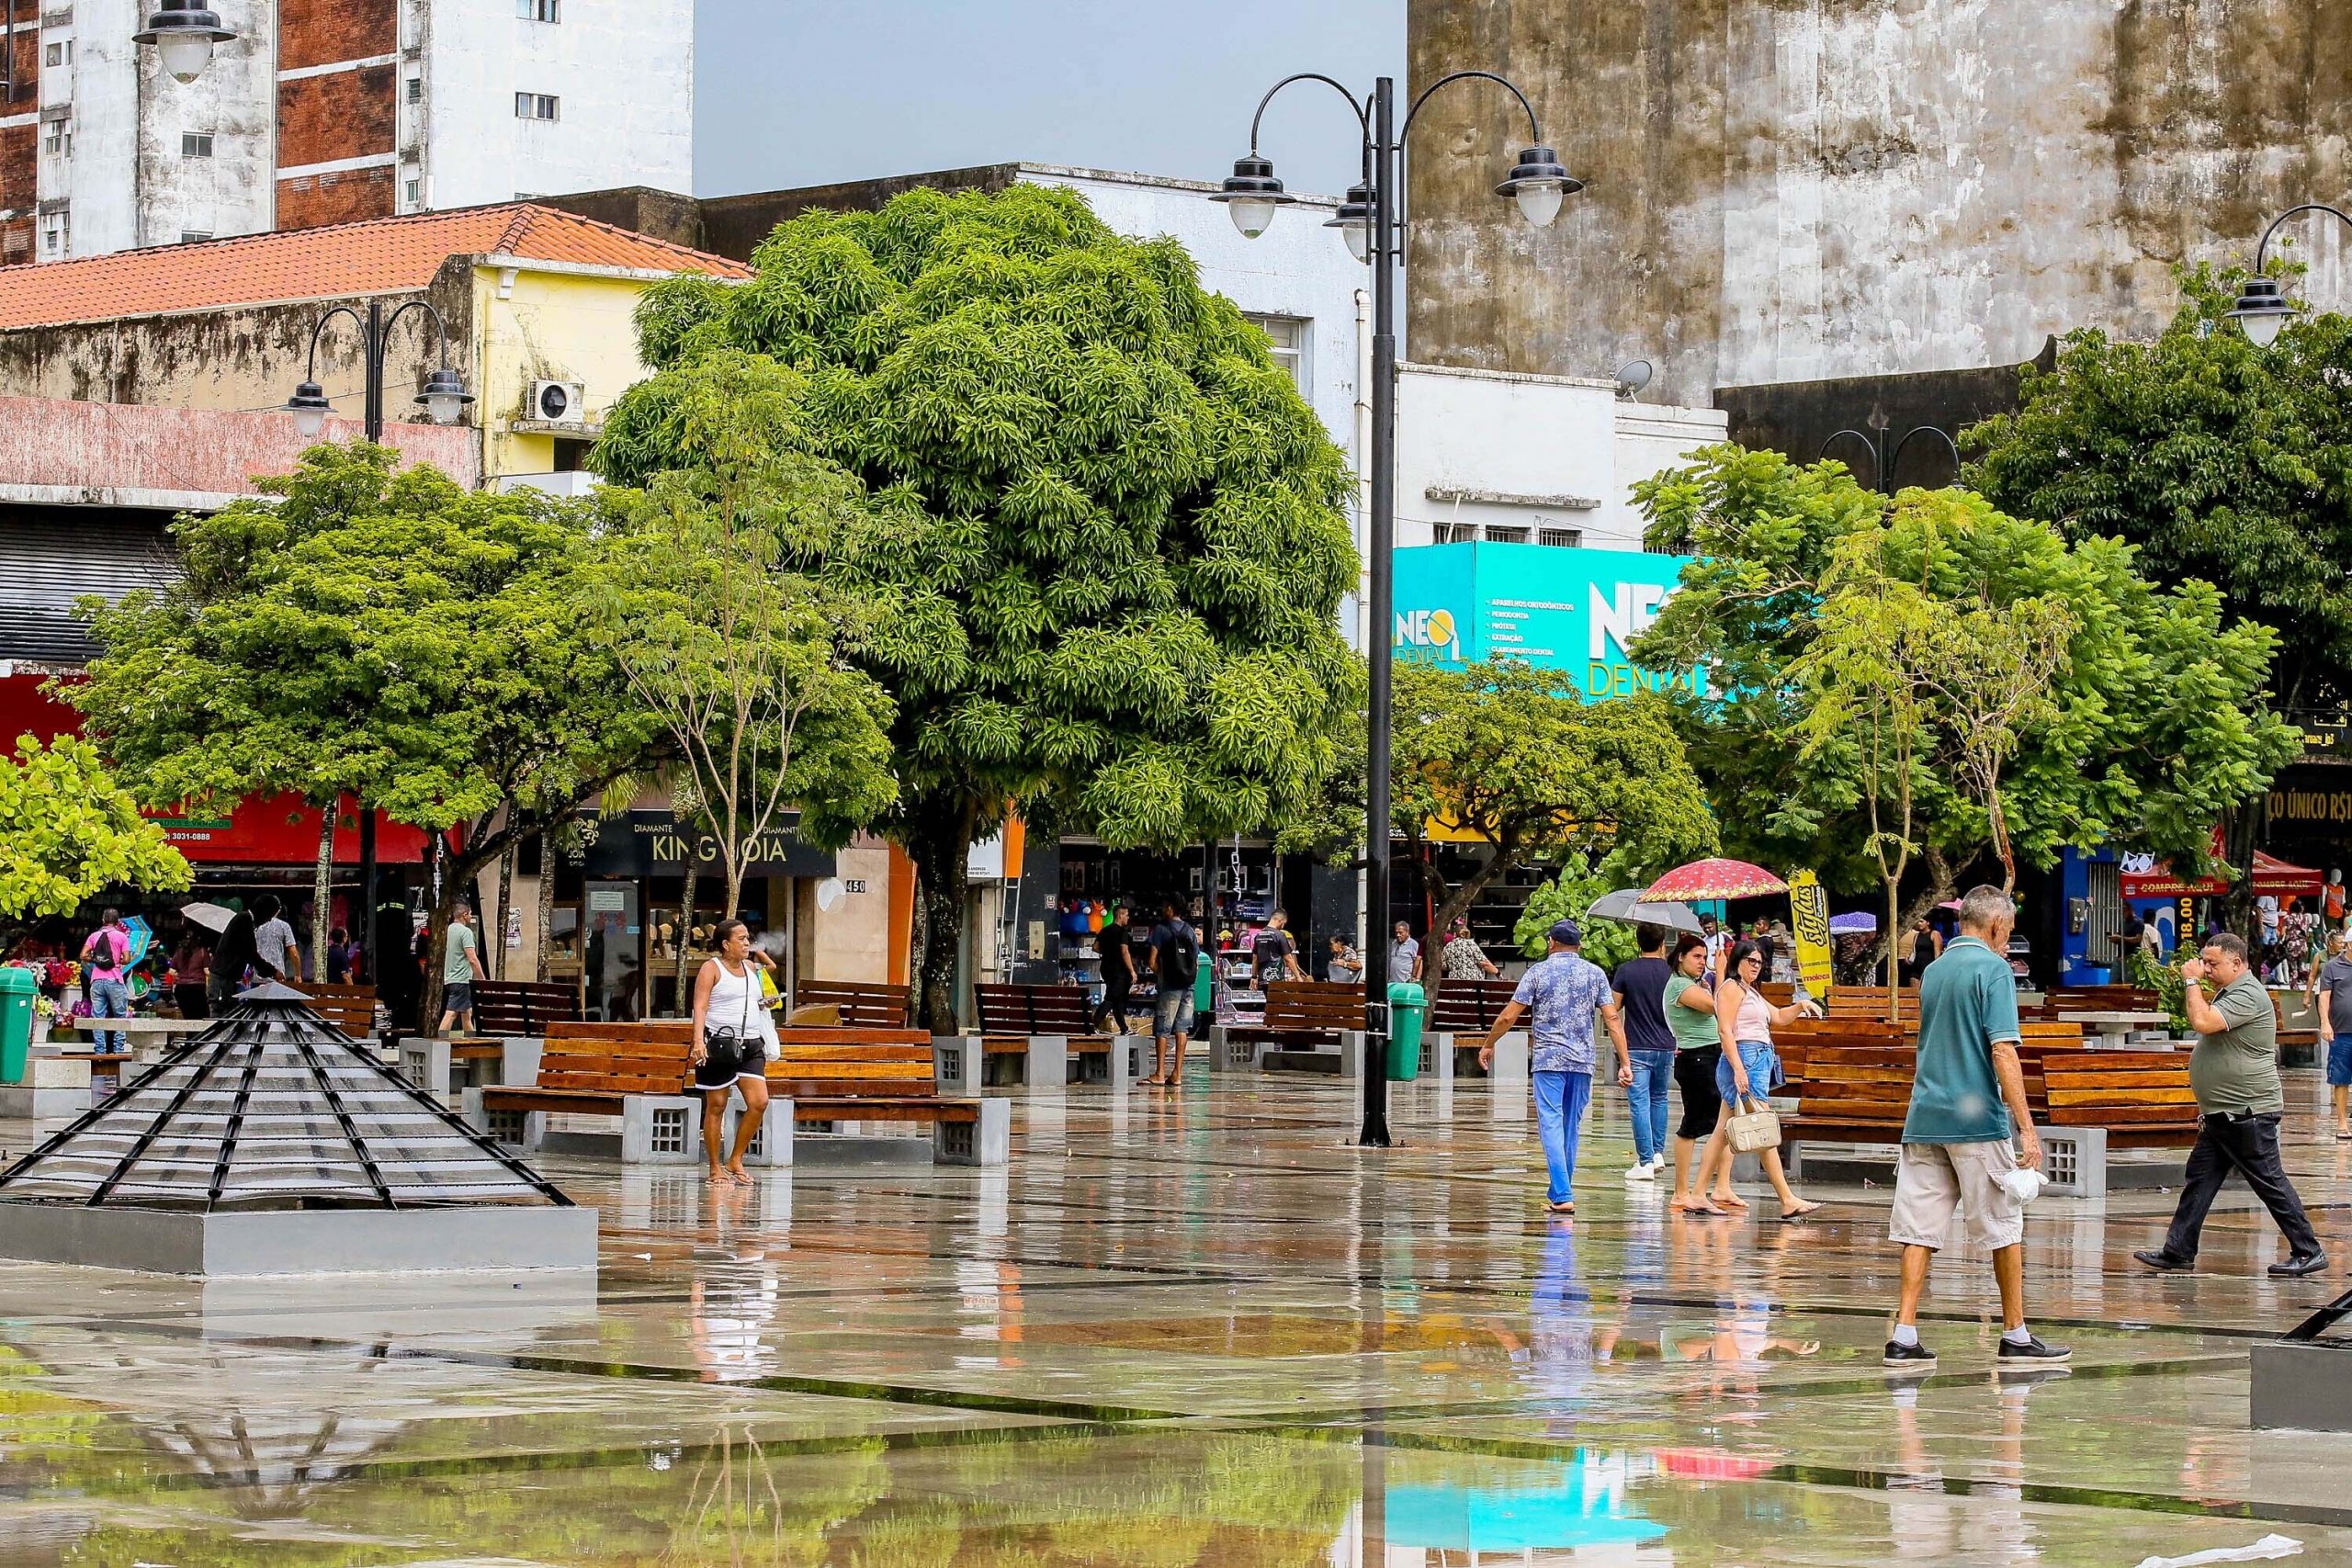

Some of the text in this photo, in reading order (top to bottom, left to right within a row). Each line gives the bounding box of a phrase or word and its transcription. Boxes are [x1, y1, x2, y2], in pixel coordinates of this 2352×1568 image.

[1492, 599, 1526, 608] APARELHOS
[1589, 581, 1683, 660] NE
[1396, 609, 1455, 647] NEO
[2288, 787, 2327, 819] ÚNICO
[634, 824, 673, 832] DIAMANTE
[172, 832, 210, 840] 3031-0888
[652, 835, 787, 862] KING OIA
[846, 881, 865, 893] 450
[2141, 883, 2185, 893] COMPRE
[2180, 897, 2195, 940] 18,00
[1803, 974, 1830, 982] moleca
